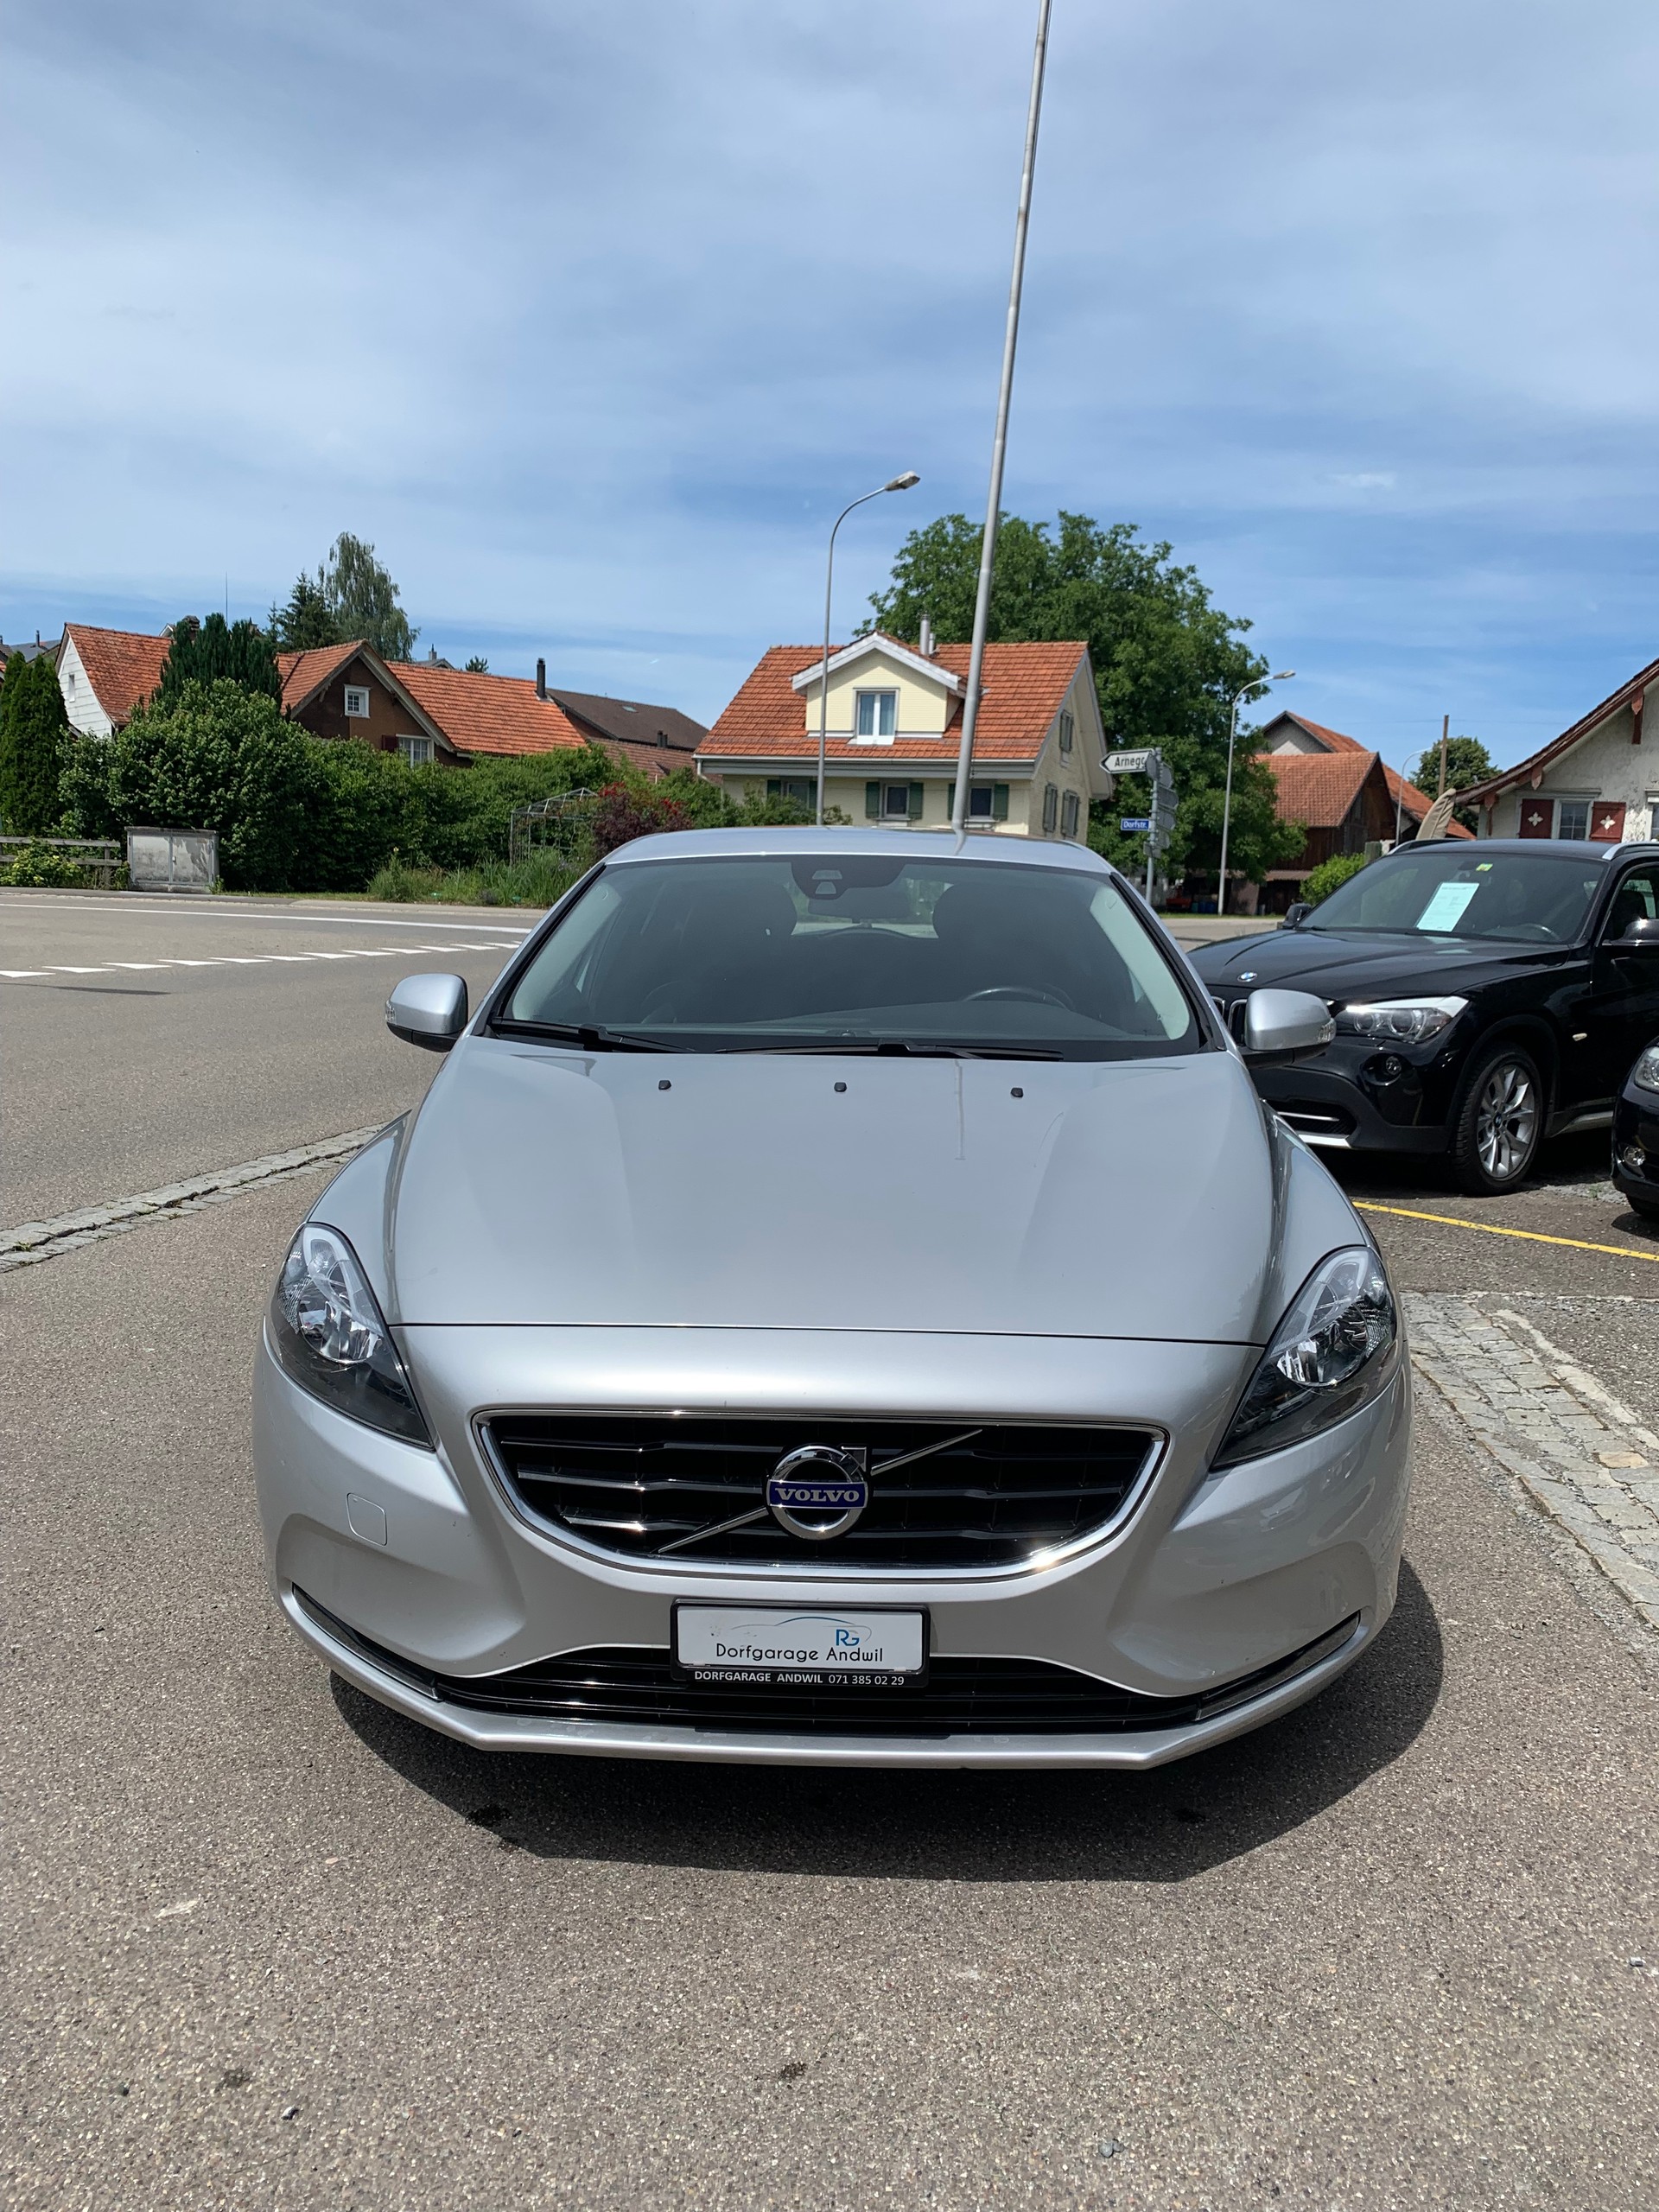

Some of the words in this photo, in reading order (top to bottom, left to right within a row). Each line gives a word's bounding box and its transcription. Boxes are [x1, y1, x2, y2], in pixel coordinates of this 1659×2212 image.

[774, 1488, 860, 1502] VOLVO
[716, 1643, 819, 1663] Dorfgarage
[826, 1647, 883, 1662] Andwil
[694, 1671, 772, 1682] DORFGARAGE
[777, 1673, 823, 1684] ANDWIL
[828, 1674, 849, 1685] 071
[851, 1675, 872, 1685] 385
[874, 1675, 888, 1686] 02
[891, 1675, 905, 1686] 29
